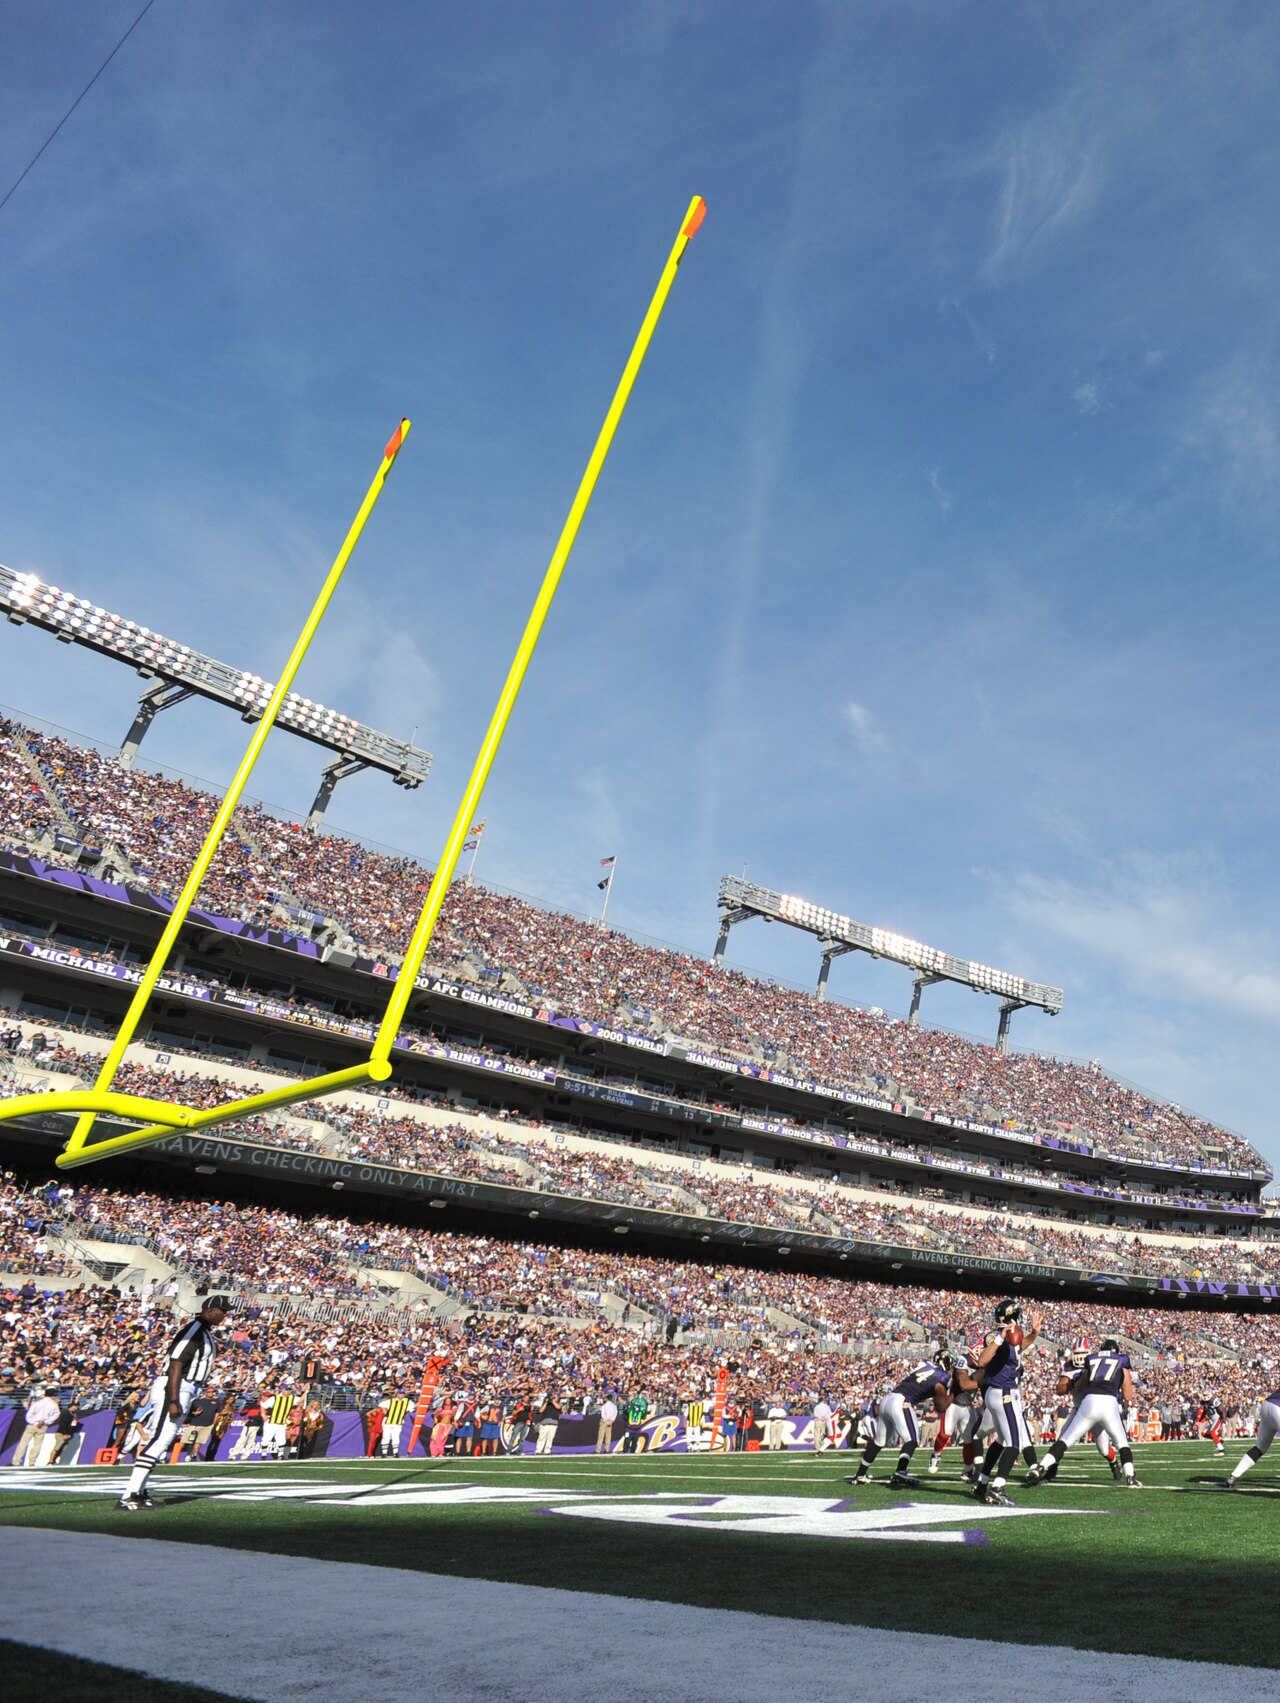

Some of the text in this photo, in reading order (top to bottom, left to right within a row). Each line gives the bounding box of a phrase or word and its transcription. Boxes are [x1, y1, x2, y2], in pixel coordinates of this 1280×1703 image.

[30, 946, 117, 976] MICHAEL
[396, 971, 533, 1018] 00 AFC CHAMPIONS
[223, 993, 258, 1008] JOHNNY
[260, 1003, 291, 1015] UNITAS
[292, 1010, 310, 1020] AND
[312, 1014, 329, 1025] THE
[329, 1020, 373, 1037] BALTIMORE
[597, 1028, 623, 1043] 2000
[626, 1035, 664, 1053] WORLD
[449, 1051, 546, 1081] RING OF HONOR
[564, 1081, 586, 1094] 9:51
[607, 1089, 627, 1098] BILLS
[589, 1090, 595, 1098] 4
[772, 1074, 893, 1112] 2003 AFC NORTH CHAMPIONS
[743, 1118, 812, 1141] RING OF HONOR
[934, 1115, 1034, 1143] 2006 AFC NORTH CHAMPIONS
[846, 1141, 880, 1155] ARTHUR
[891, 1150, 921, 1163] MODELL
[251, 1151, 352, 1177] CHECKING
[360, 1168, 409, 1185] ONLY
[412, 1176, 437, 1190] AT
[440, 1180, 479, 1197] M&T
[931, 1159, 991, 1176] EARNEST BYNER
[1001, 1173, 1060, 1189] PETER BOULWARE
[911, 1251, 1056, 1277] RAVENS CHECKING ONLY AT M&T
[306, 1363, 315, 1378] 1
[1089, 1358, 1118, 1381] 77
[101, 1450, 112, 1462] G
